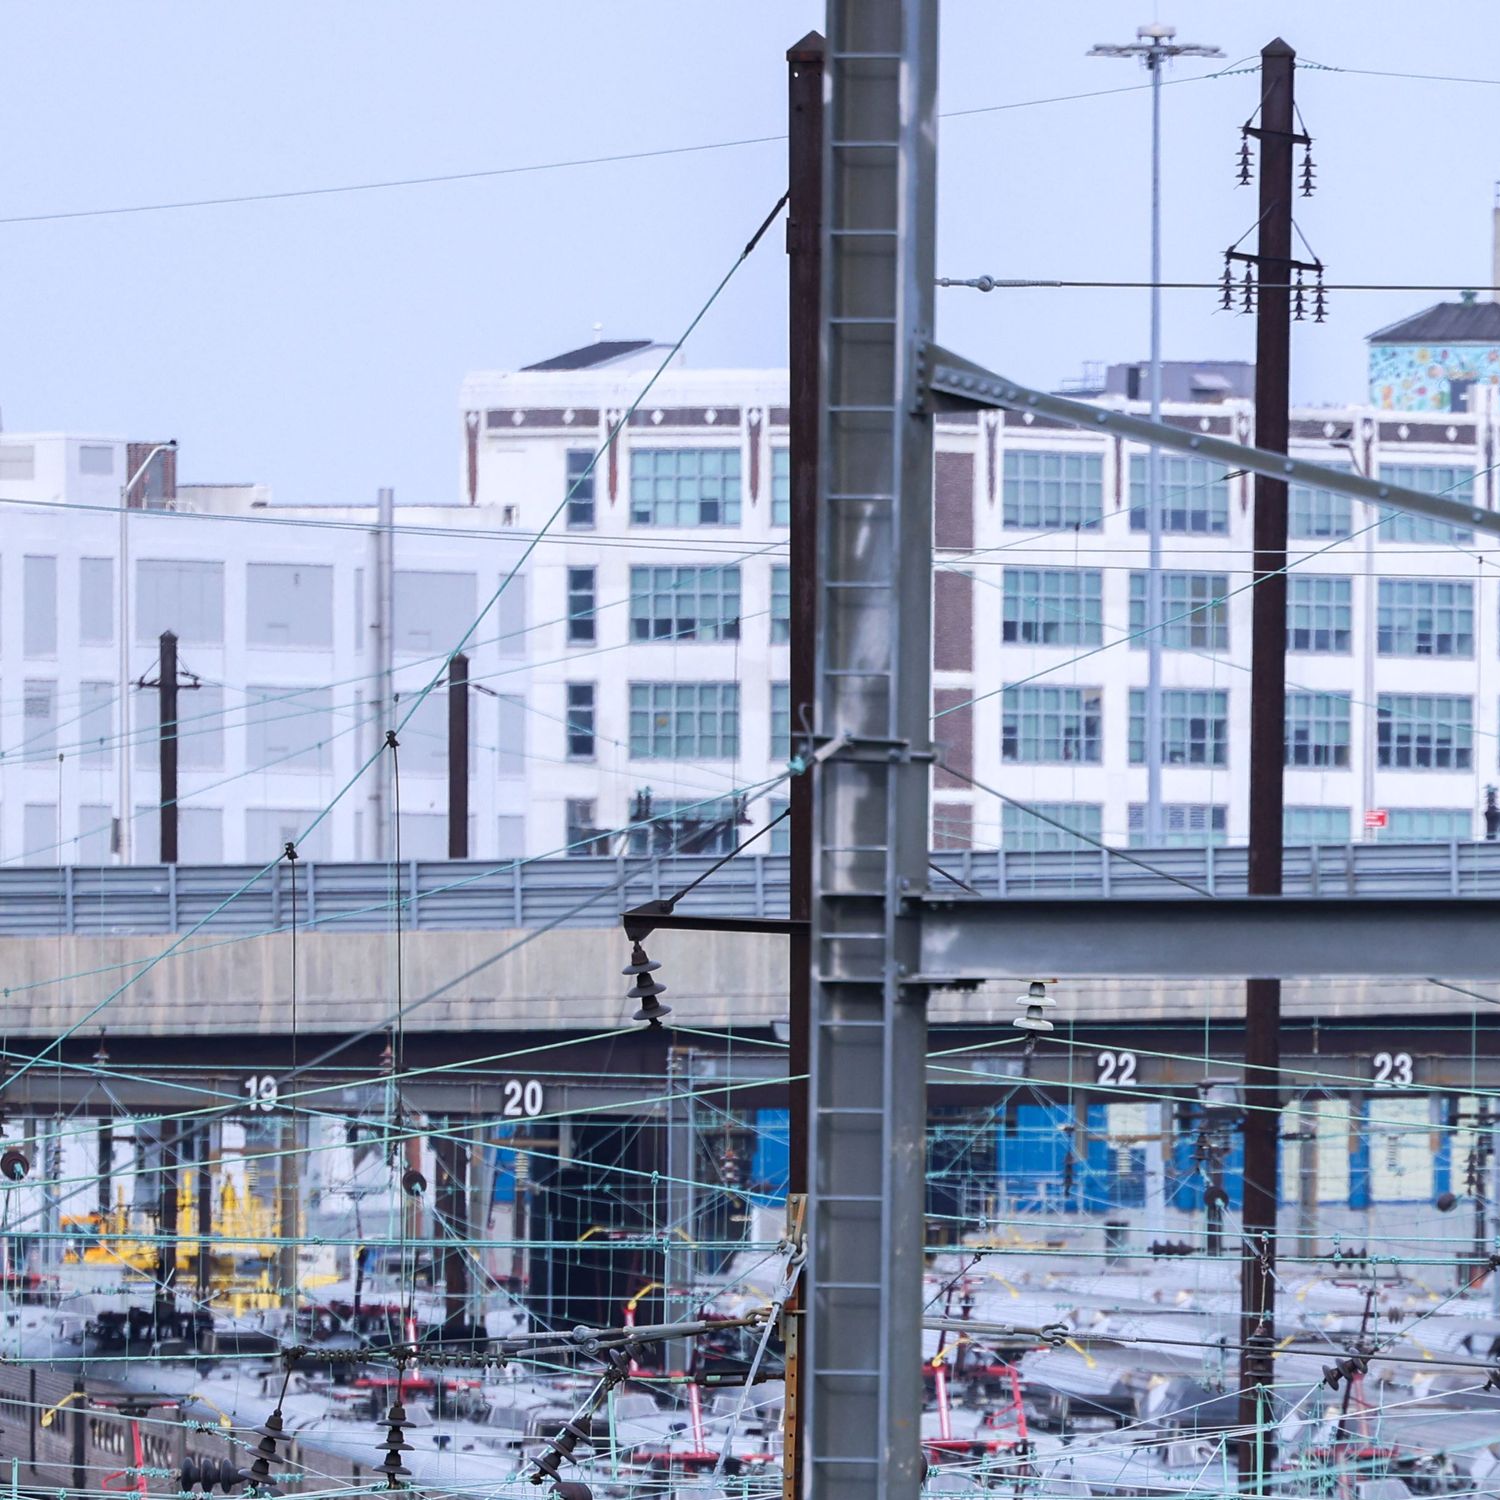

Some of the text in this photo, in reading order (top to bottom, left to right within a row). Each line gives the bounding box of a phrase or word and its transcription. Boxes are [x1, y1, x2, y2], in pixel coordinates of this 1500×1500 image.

[1097, 1051, 1136, 1086] 22
[1373, 1052, 1413, 1088] 23
[245, 1075, 278, 1112] 19
[504, 1079, 543, 1116] 20
